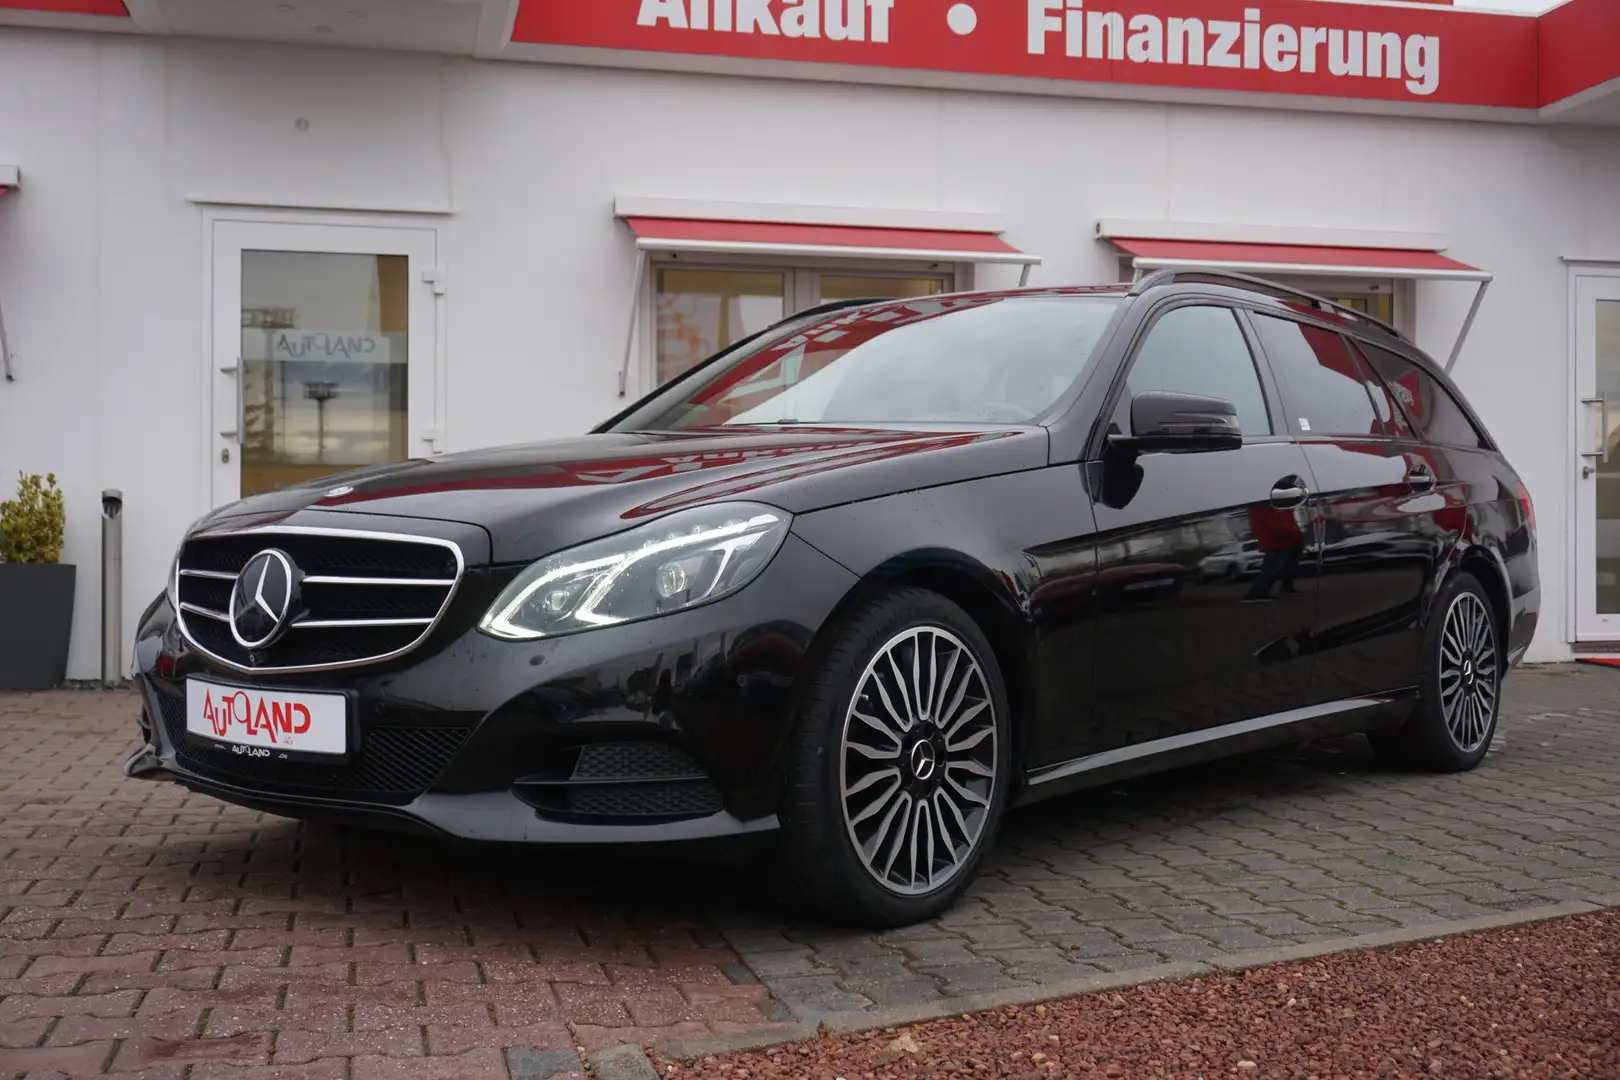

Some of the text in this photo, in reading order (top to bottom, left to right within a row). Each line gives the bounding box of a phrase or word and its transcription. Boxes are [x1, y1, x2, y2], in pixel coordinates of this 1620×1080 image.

[1027, 0, 1440, 94] Finanzierung
[203, 688, 311, 743] AUTOLAND
[232, 745, 271, 758] AUTOLAND
